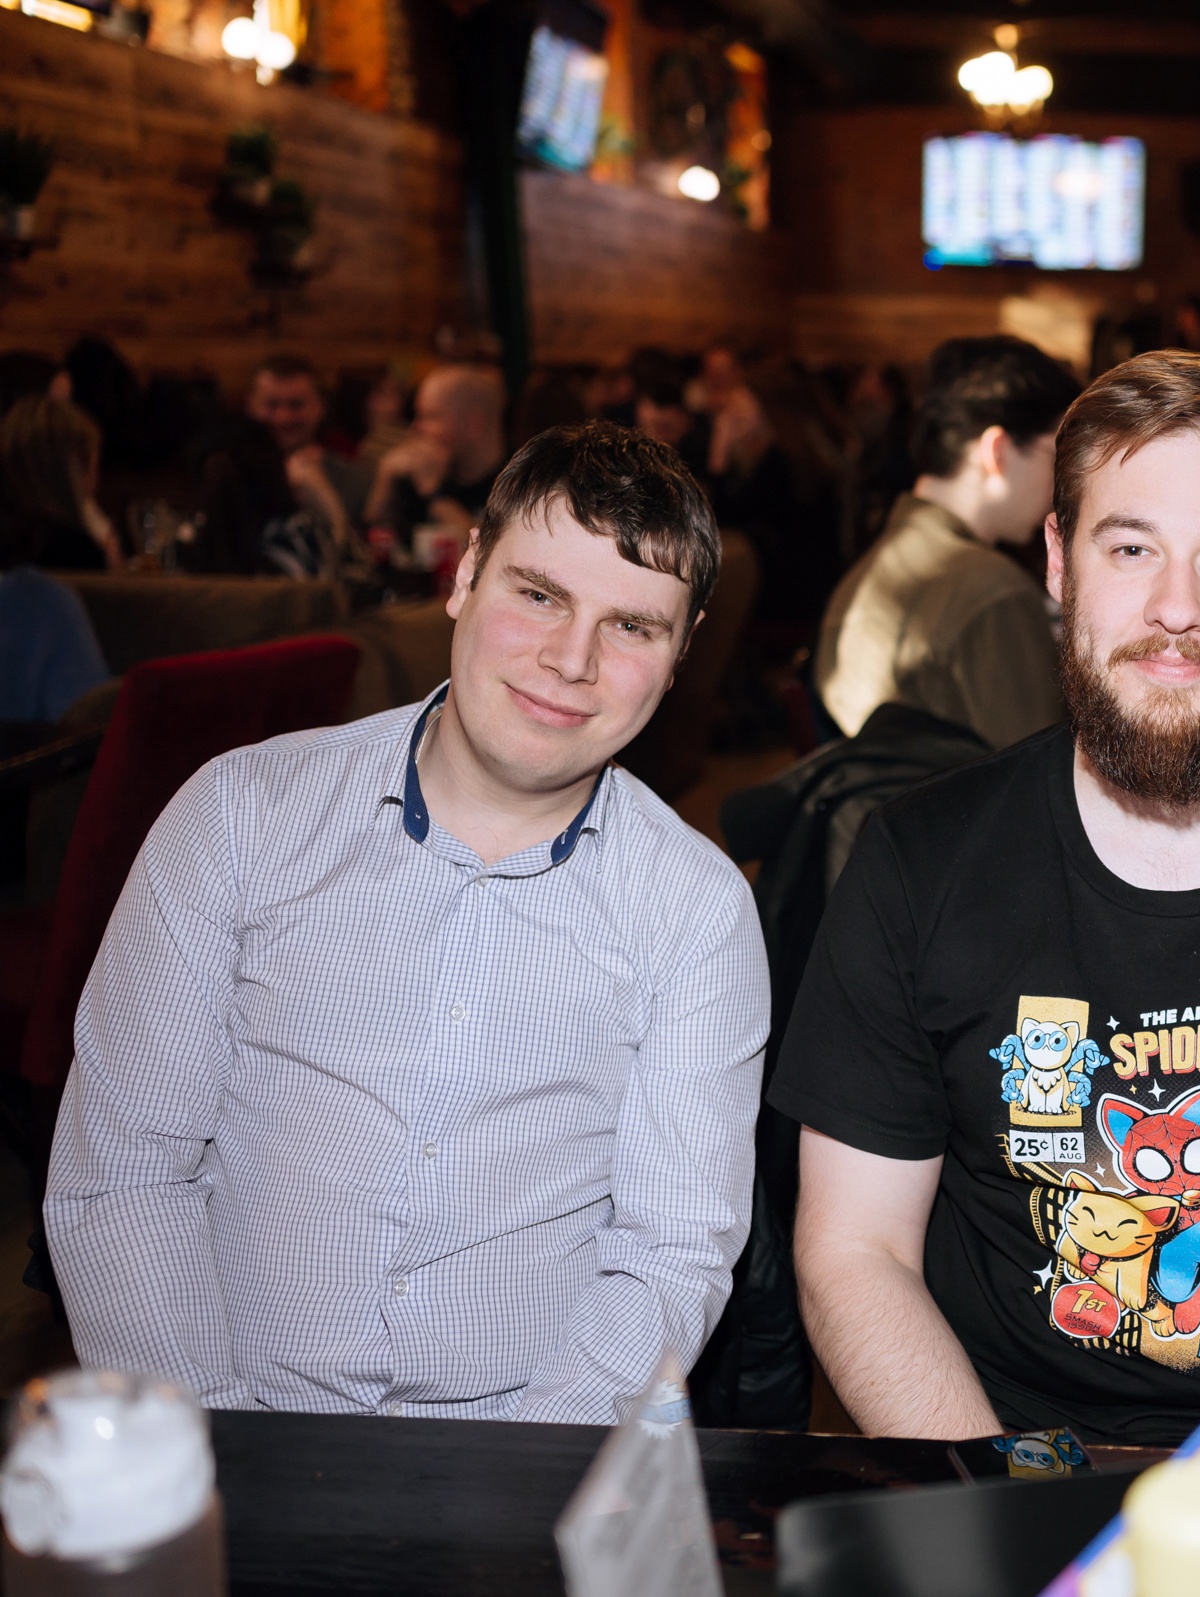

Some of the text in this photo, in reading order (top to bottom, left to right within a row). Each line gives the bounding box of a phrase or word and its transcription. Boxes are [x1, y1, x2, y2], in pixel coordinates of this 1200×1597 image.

[1140, 1008, 1178, 1027] THE
[1014, 1137, 1049, 1157] 25¢
[1060, 1137, 1078, 1151] 62
[1059, 1152, 1082, 1160] AUG
[1071, 1289, 1108, 1313] 1ST
[1064, 1313, 1102, 1331] SMASH
